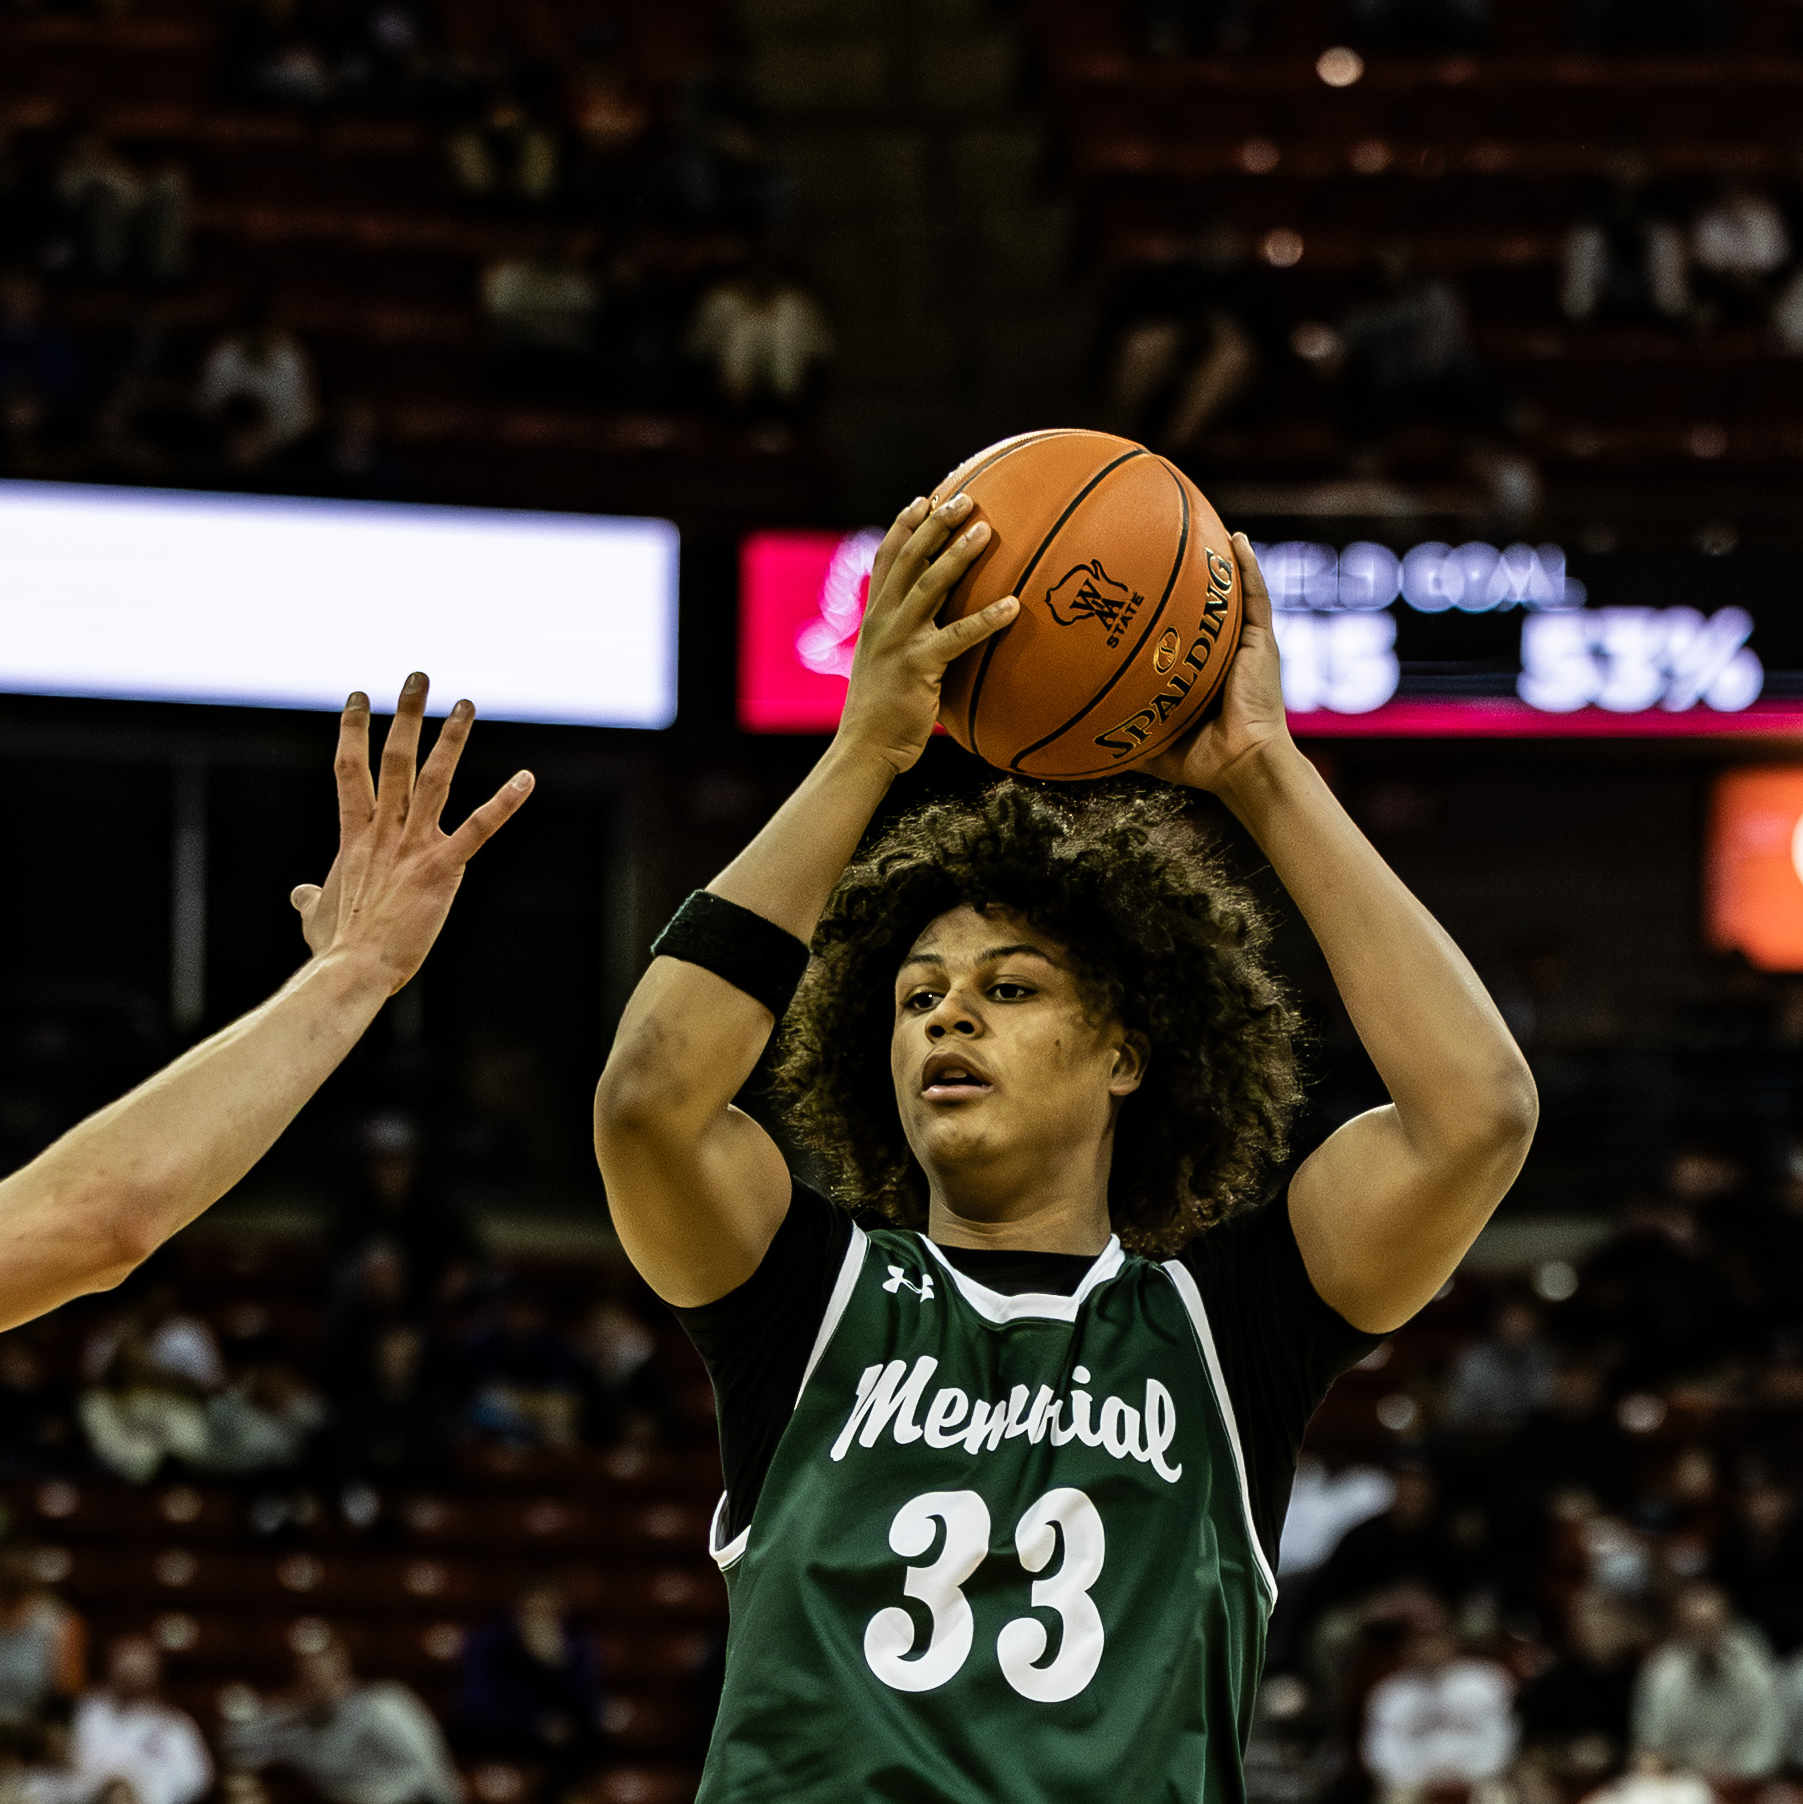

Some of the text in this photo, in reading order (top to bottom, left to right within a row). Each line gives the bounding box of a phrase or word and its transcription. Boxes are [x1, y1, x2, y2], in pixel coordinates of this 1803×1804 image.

[1106, 591, 1145, 649] STATE
[1252, 541, 1400, 613] ELD
[1093, 547, 1235, 760] SPALDING
[1516, 605, 1765, 714] 53%
[864, 1487, 1105, 1702] 33
